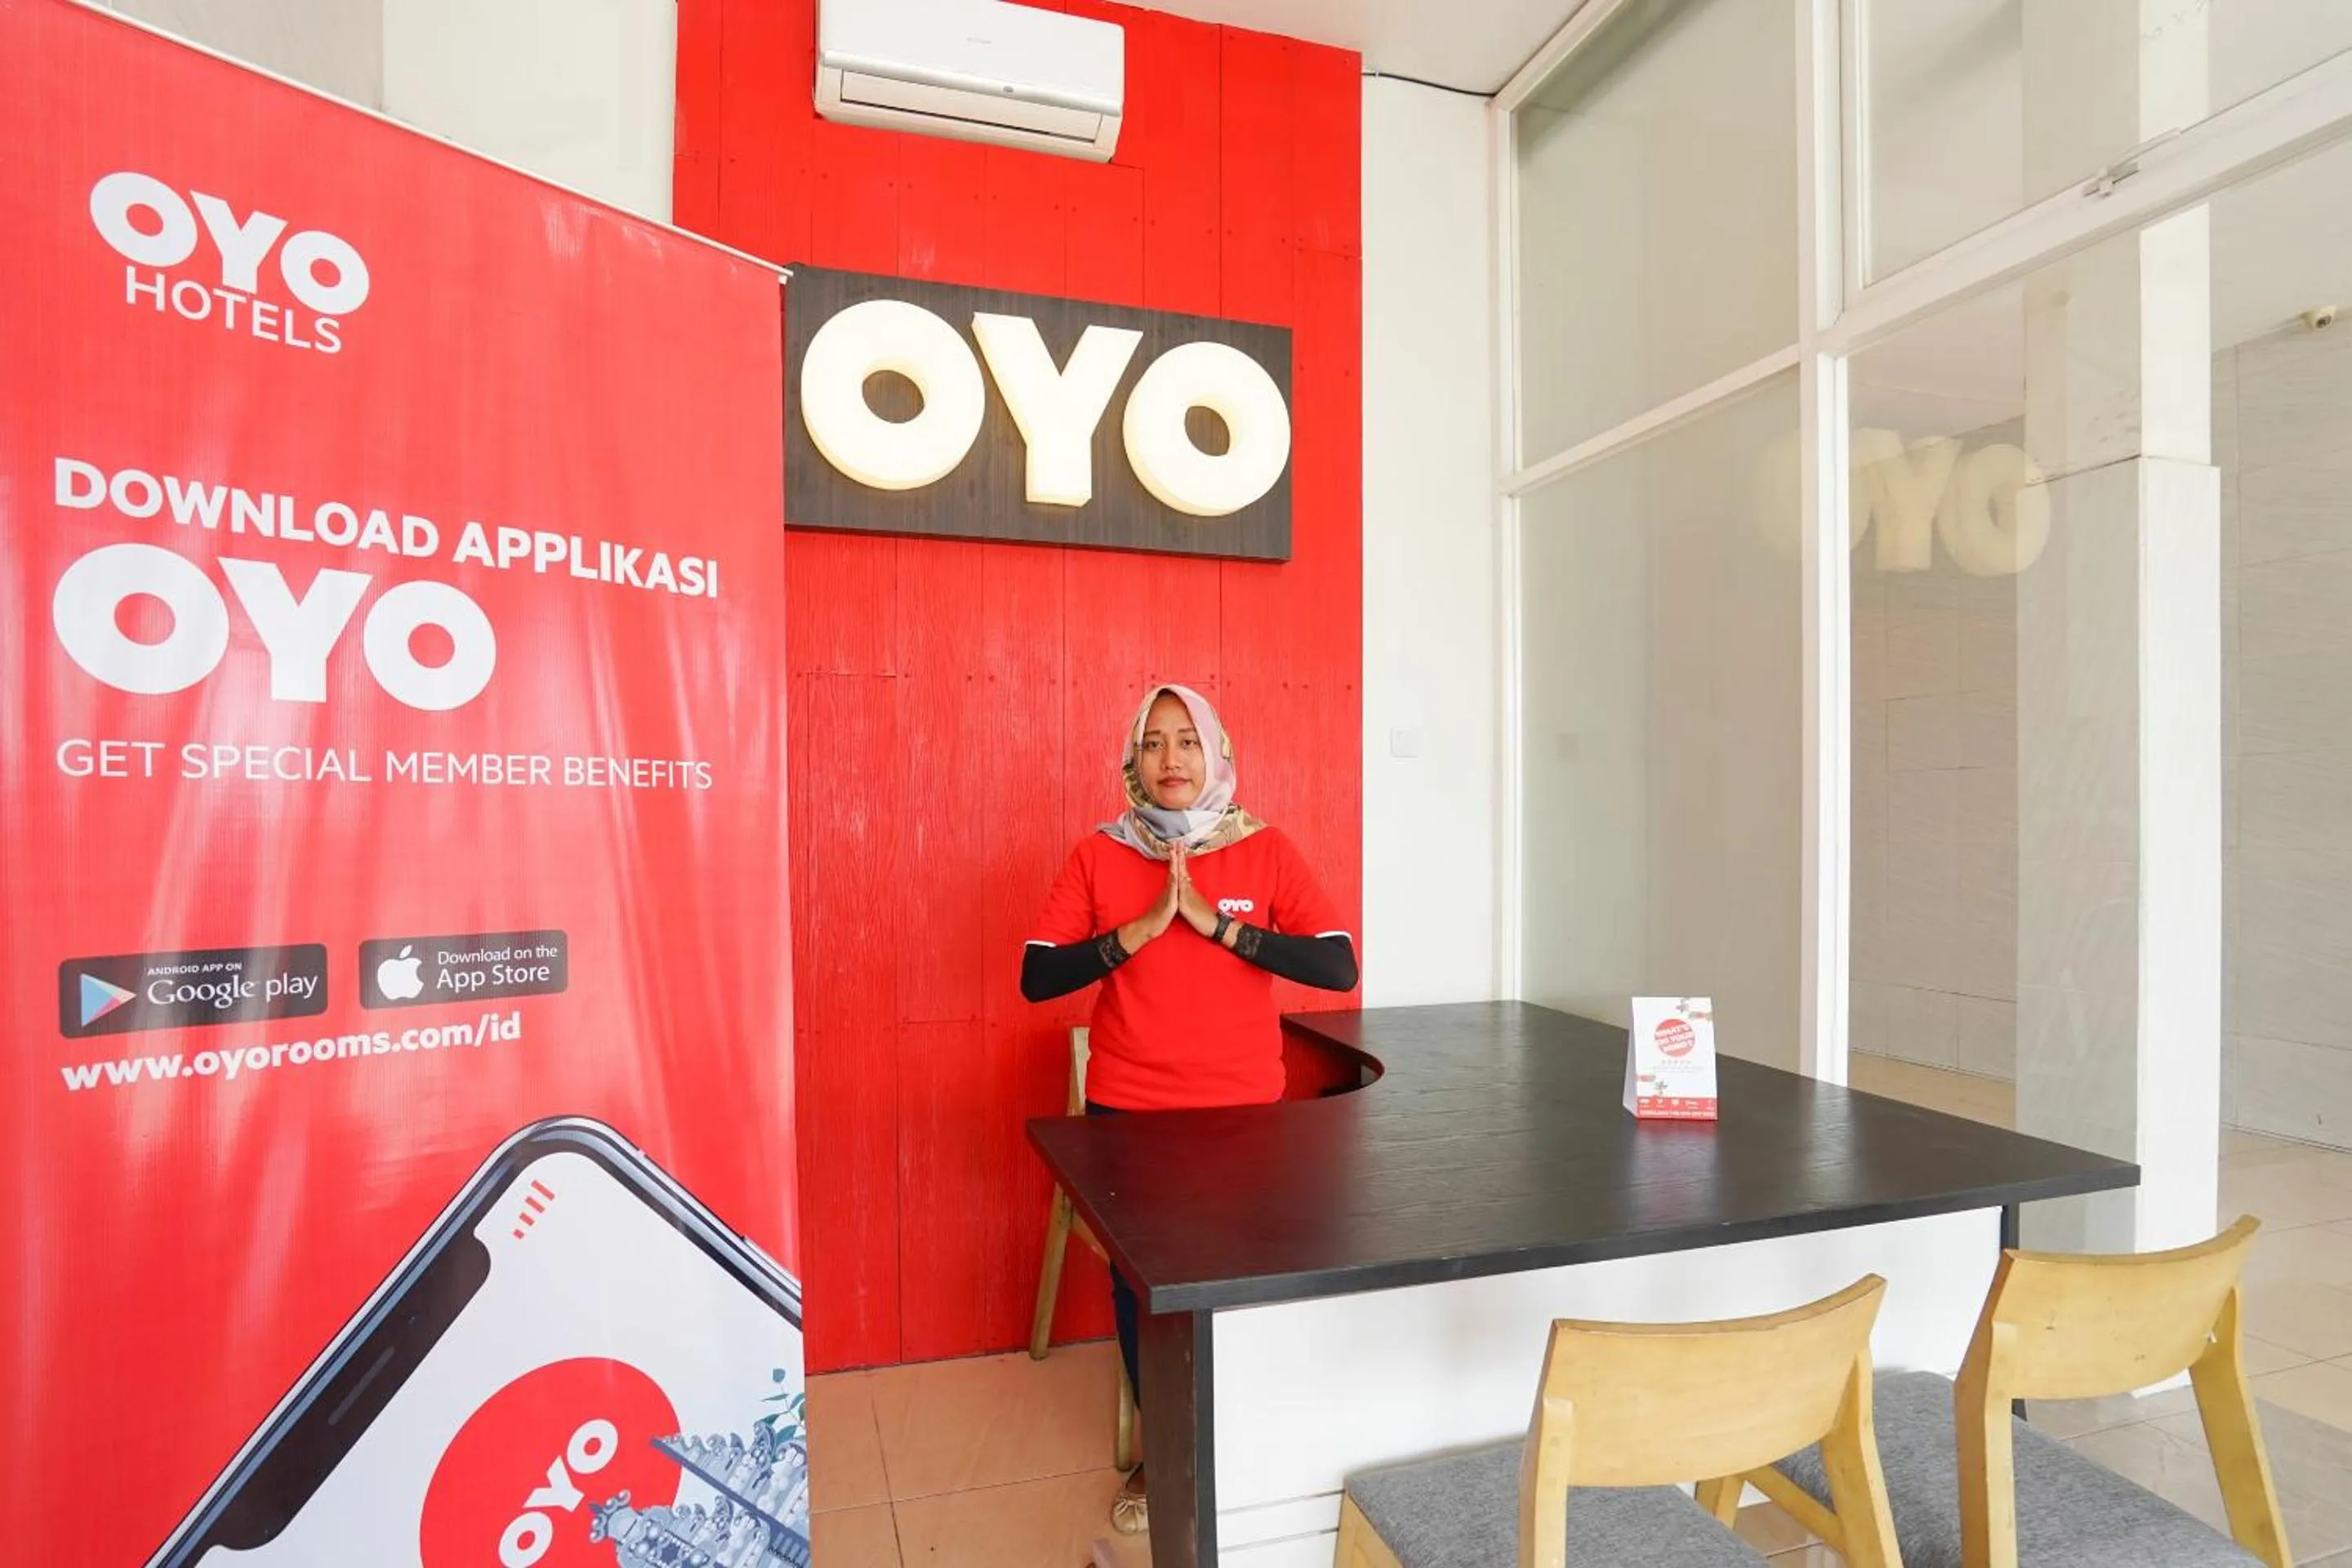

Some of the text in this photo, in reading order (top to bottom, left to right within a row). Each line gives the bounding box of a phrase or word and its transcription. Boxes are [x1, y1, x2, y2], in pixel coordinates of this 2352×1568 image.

[90, 172, 369, 314] OYO
[127, 266, 341, 354] HOTELS
[801, 299, 1291, 517] OYO
[55, 457, 719, 599] DOWNLOAD APPLIKASI
[52, 543, 497, 711] OYO
[56, 738, 714, 791] GET SPECIAL MEMBER BENEFITS
[1218, 898, 1254, 912] OYO
[147, 962, 242, 976] ANDROID APP ON
[147, 973, 318, 1009] Google play
[436, 964, 550, 993] App Store
[438, 945, 558, 965] Download on the
[61, 1011, 520, 1091] www.oyorooms.com/id
[499, 1419, 618, 1568] OYO
